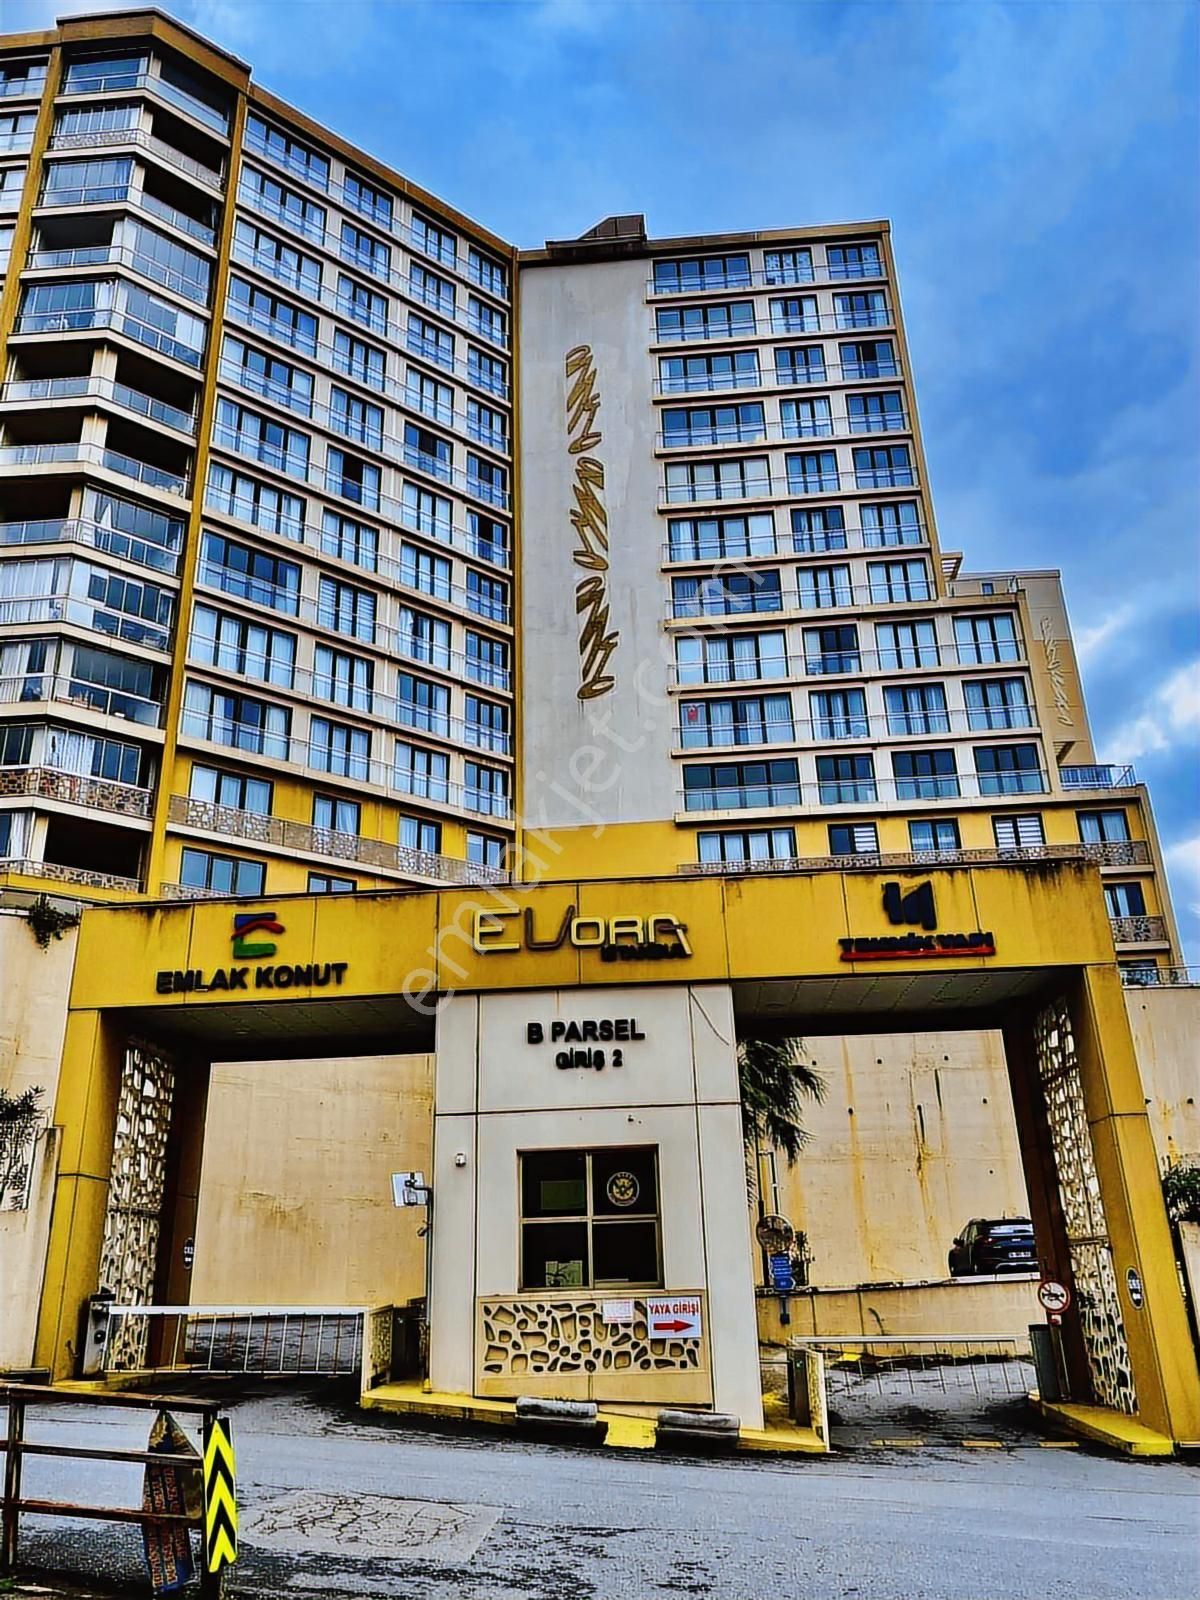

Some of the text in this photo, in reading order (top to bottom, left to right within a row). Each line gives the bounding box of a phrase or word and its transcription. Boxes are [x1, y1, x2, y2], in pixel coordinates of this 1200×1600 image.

[156, 962, 348, 994] EMLAK KONUT
[527, 1018, 645, 1044] B PARSEL
[612, 1048, 623, 1067] 2
[648, 1303, 671, 1315] YAYA
[672, 1300, 699, 1316] GİRİŞİ
